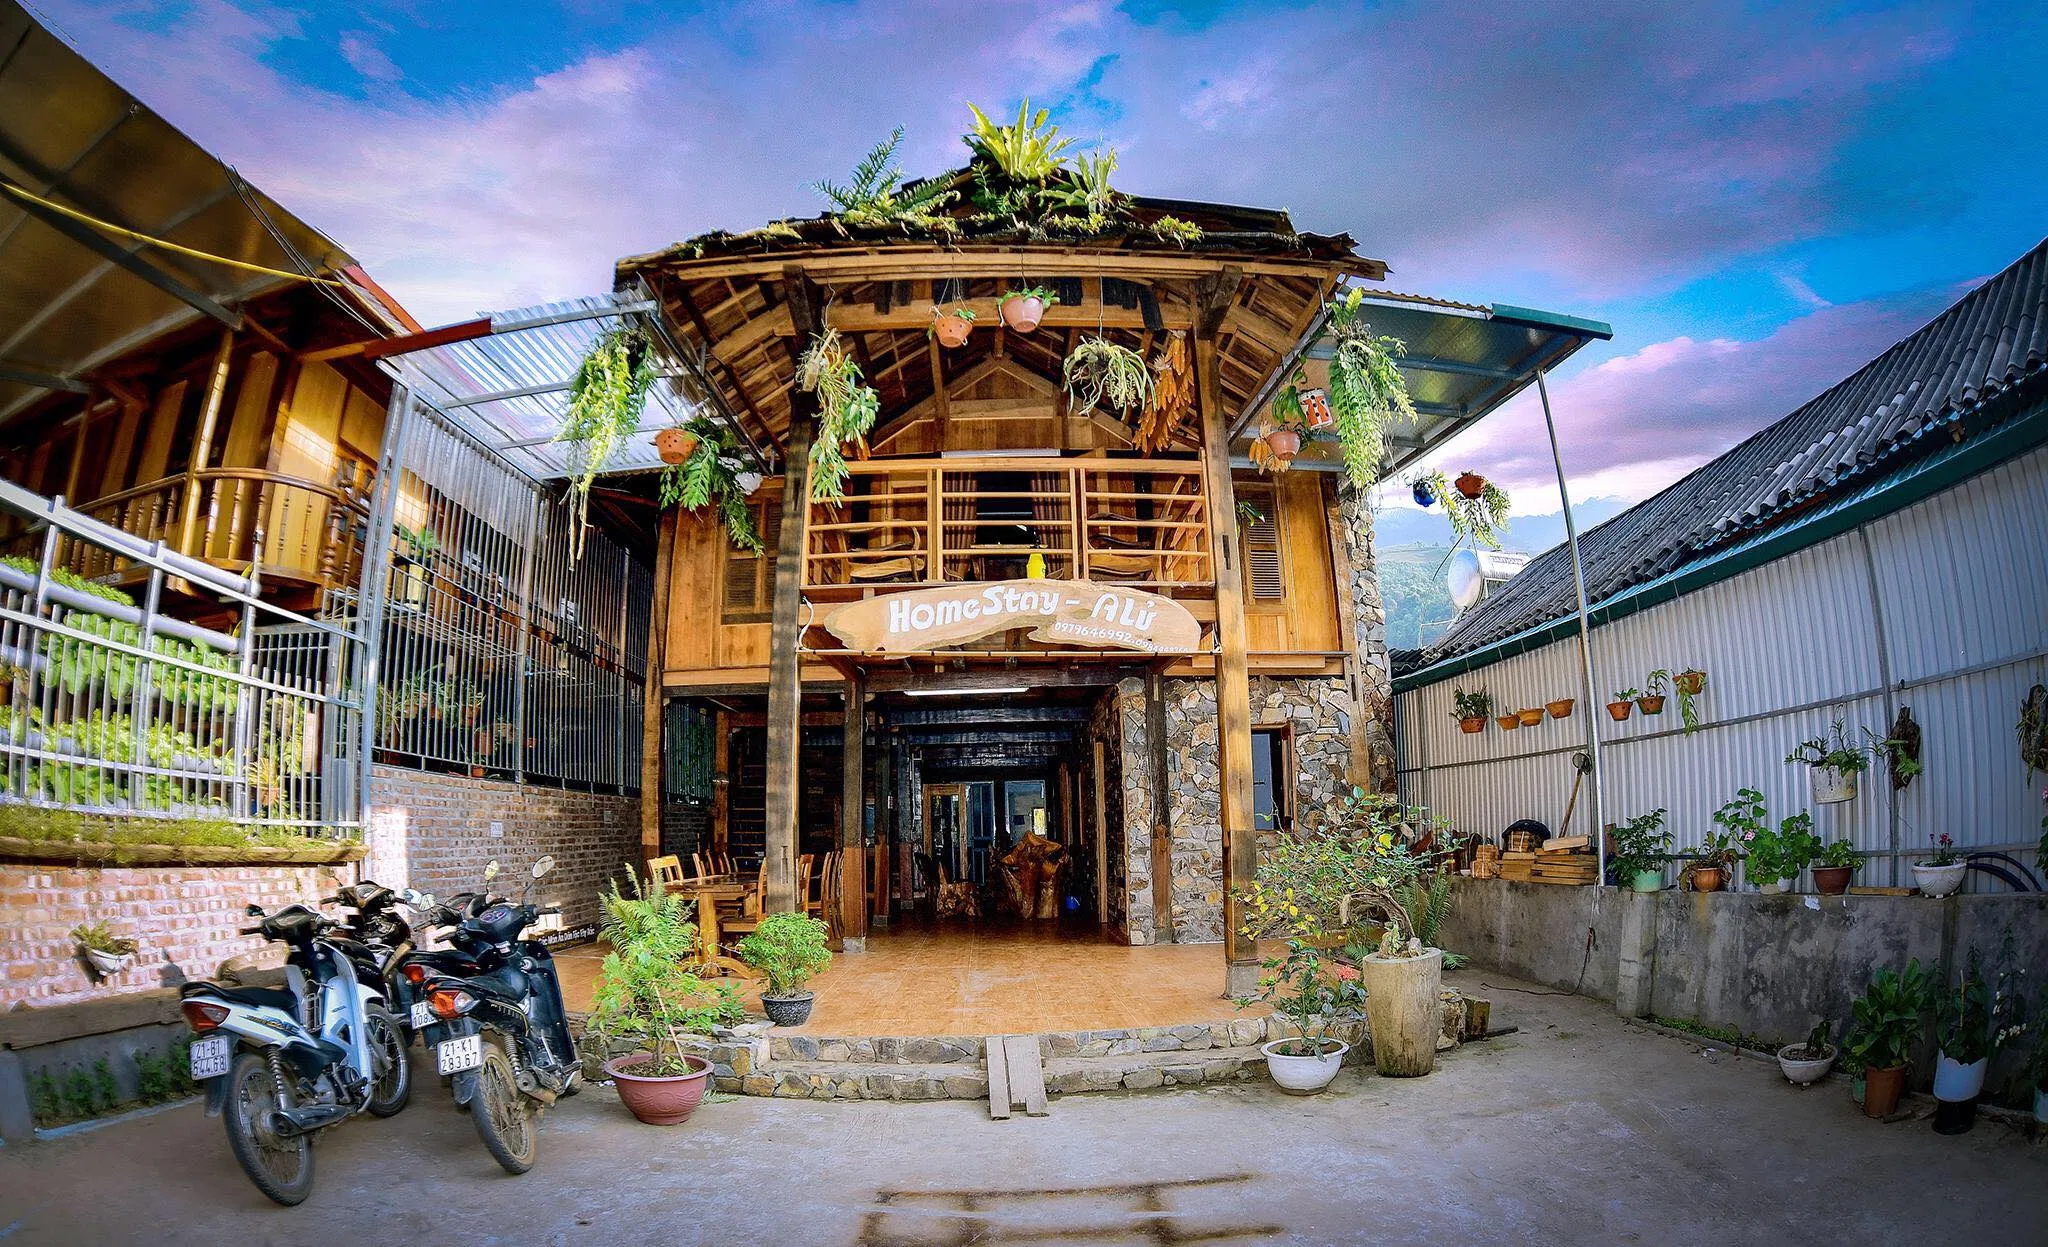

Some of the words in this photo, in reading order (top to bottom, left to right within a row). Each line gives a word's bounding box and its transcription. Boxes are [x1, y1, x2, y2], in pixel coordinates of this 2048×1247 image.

[889, 585, 1060, 633] HomeStay
[444, 1038, 472, 1057] 21-K1
[441, 1052, 477, 1072] 283.67
